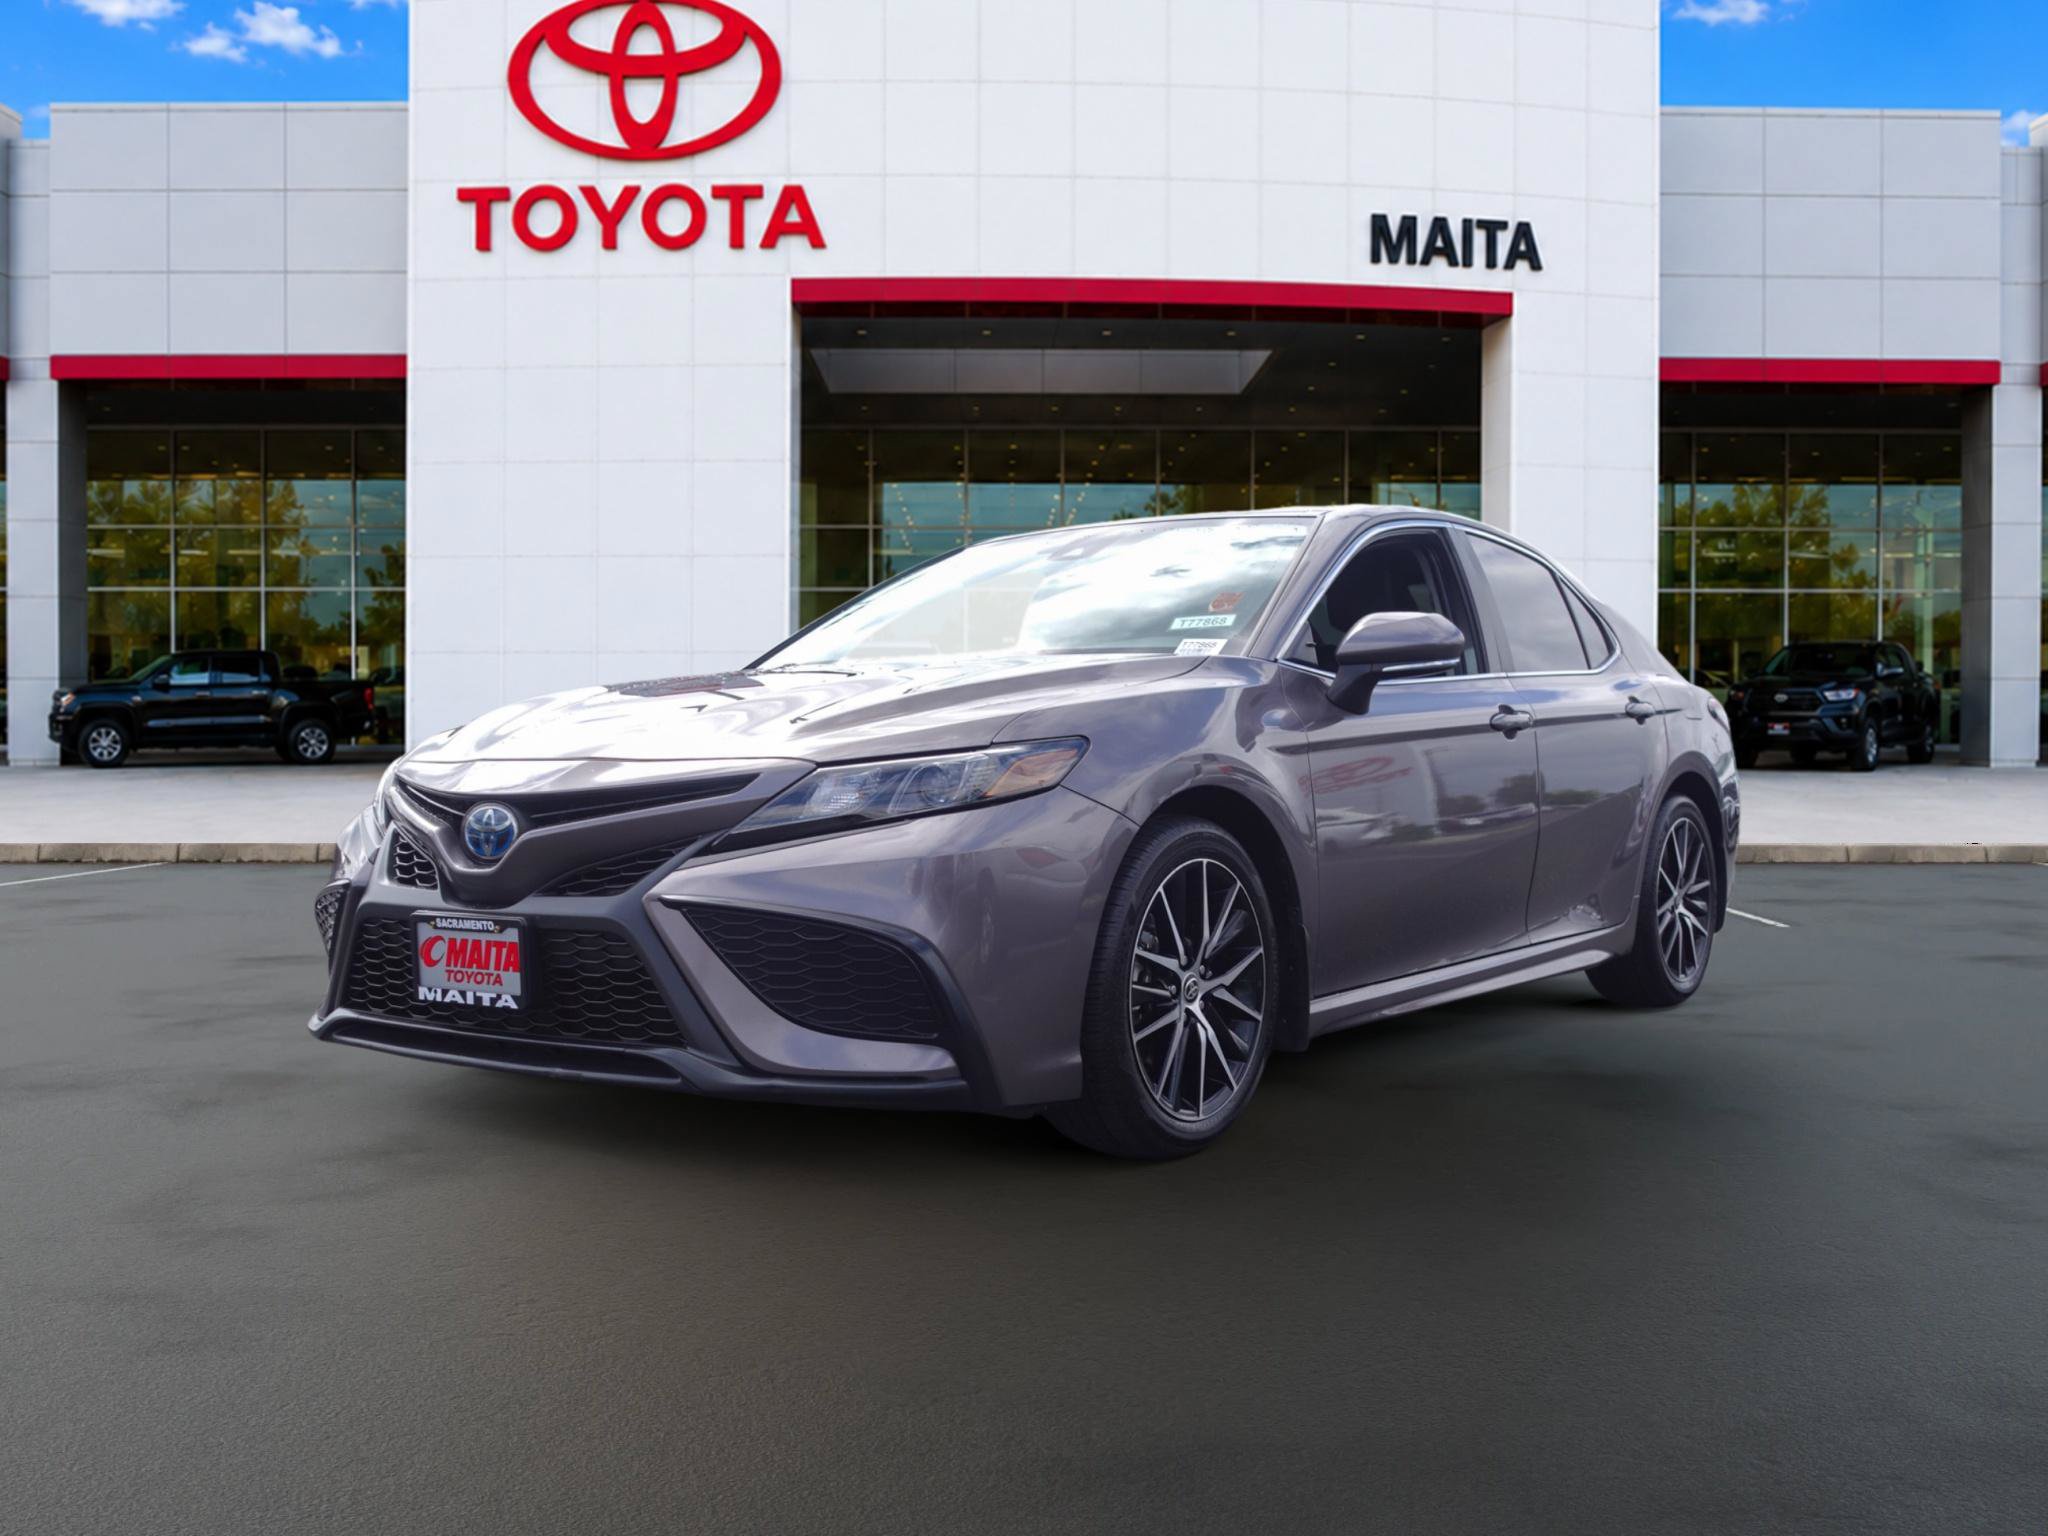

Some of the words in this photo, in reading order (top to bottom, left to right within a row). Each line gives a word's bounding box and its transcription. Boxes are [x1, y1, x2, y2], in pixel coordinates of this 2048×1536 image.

[457, 183, 827, 252] TOYOTA
[1370, 213, 1543, 271] MAITA
[435, 917, 494, 931] SACRAMENTO
[446, 938, 520, 972] MAITA
[445, 969, 503, 986] TOYOTA
[418, 986, 518, 1009] MAITA
